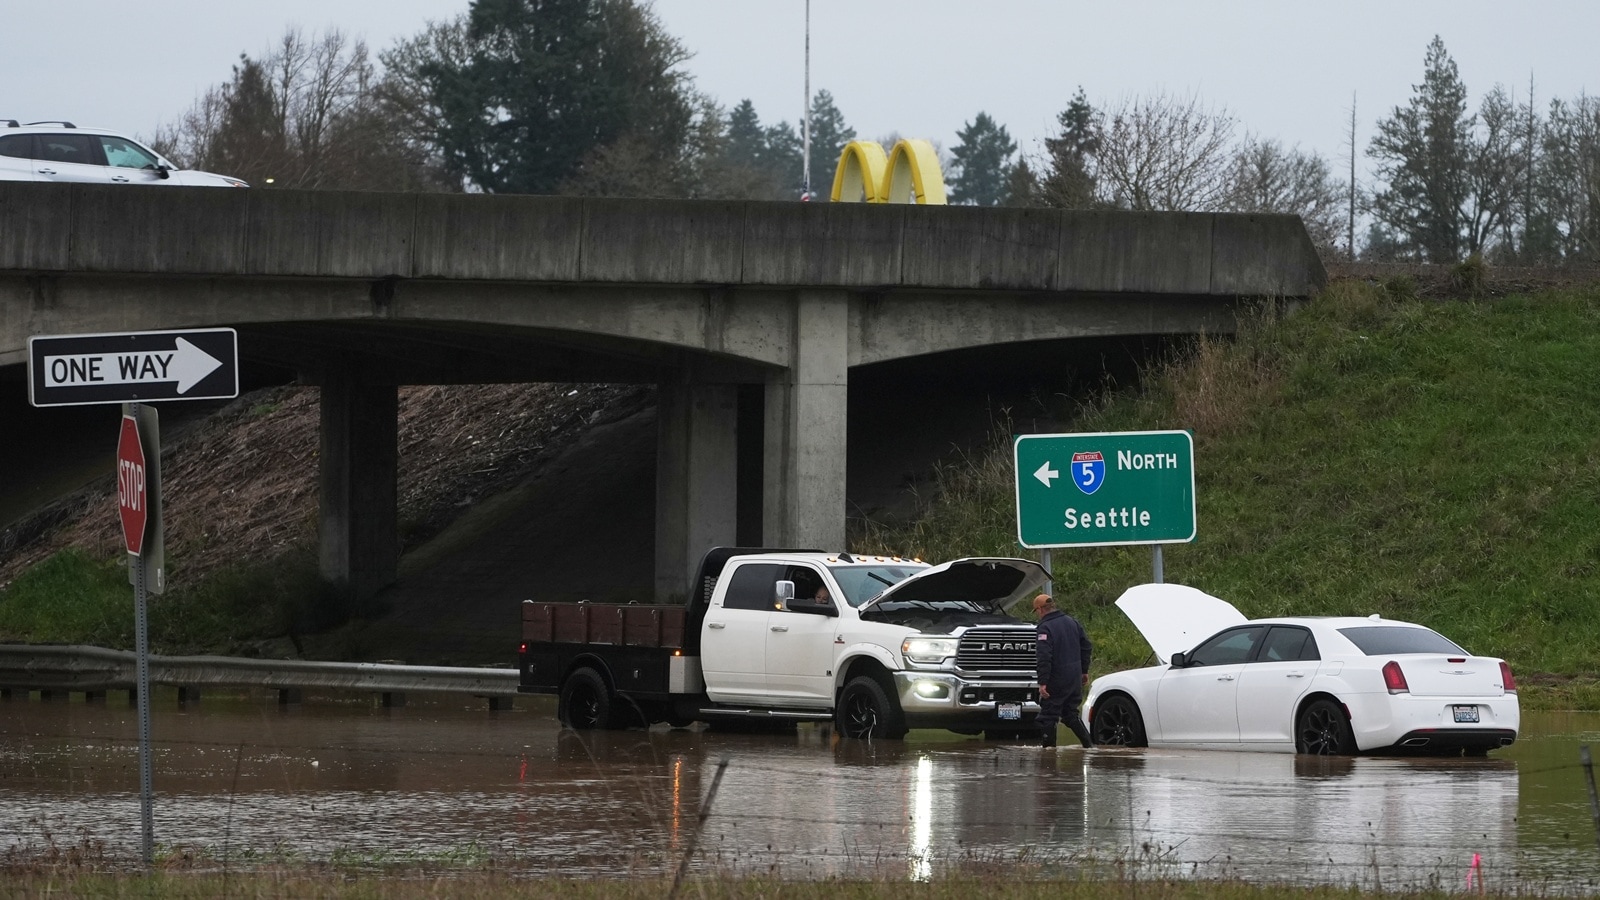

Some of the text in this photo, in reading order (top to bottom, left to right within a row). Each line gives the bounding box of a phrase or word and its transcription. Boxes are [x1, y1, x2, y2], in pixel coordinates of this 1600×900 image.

[51, 353, 174, 384] ONE WAY
[1118, 450, 1177, 470] NORTH
[119, 458, 144, 512] STOP
[1082, 462, 1095, 486] 5
[1064, 507, 1151, 528] Seattle
[988, 642, 1027, 650] RAM
